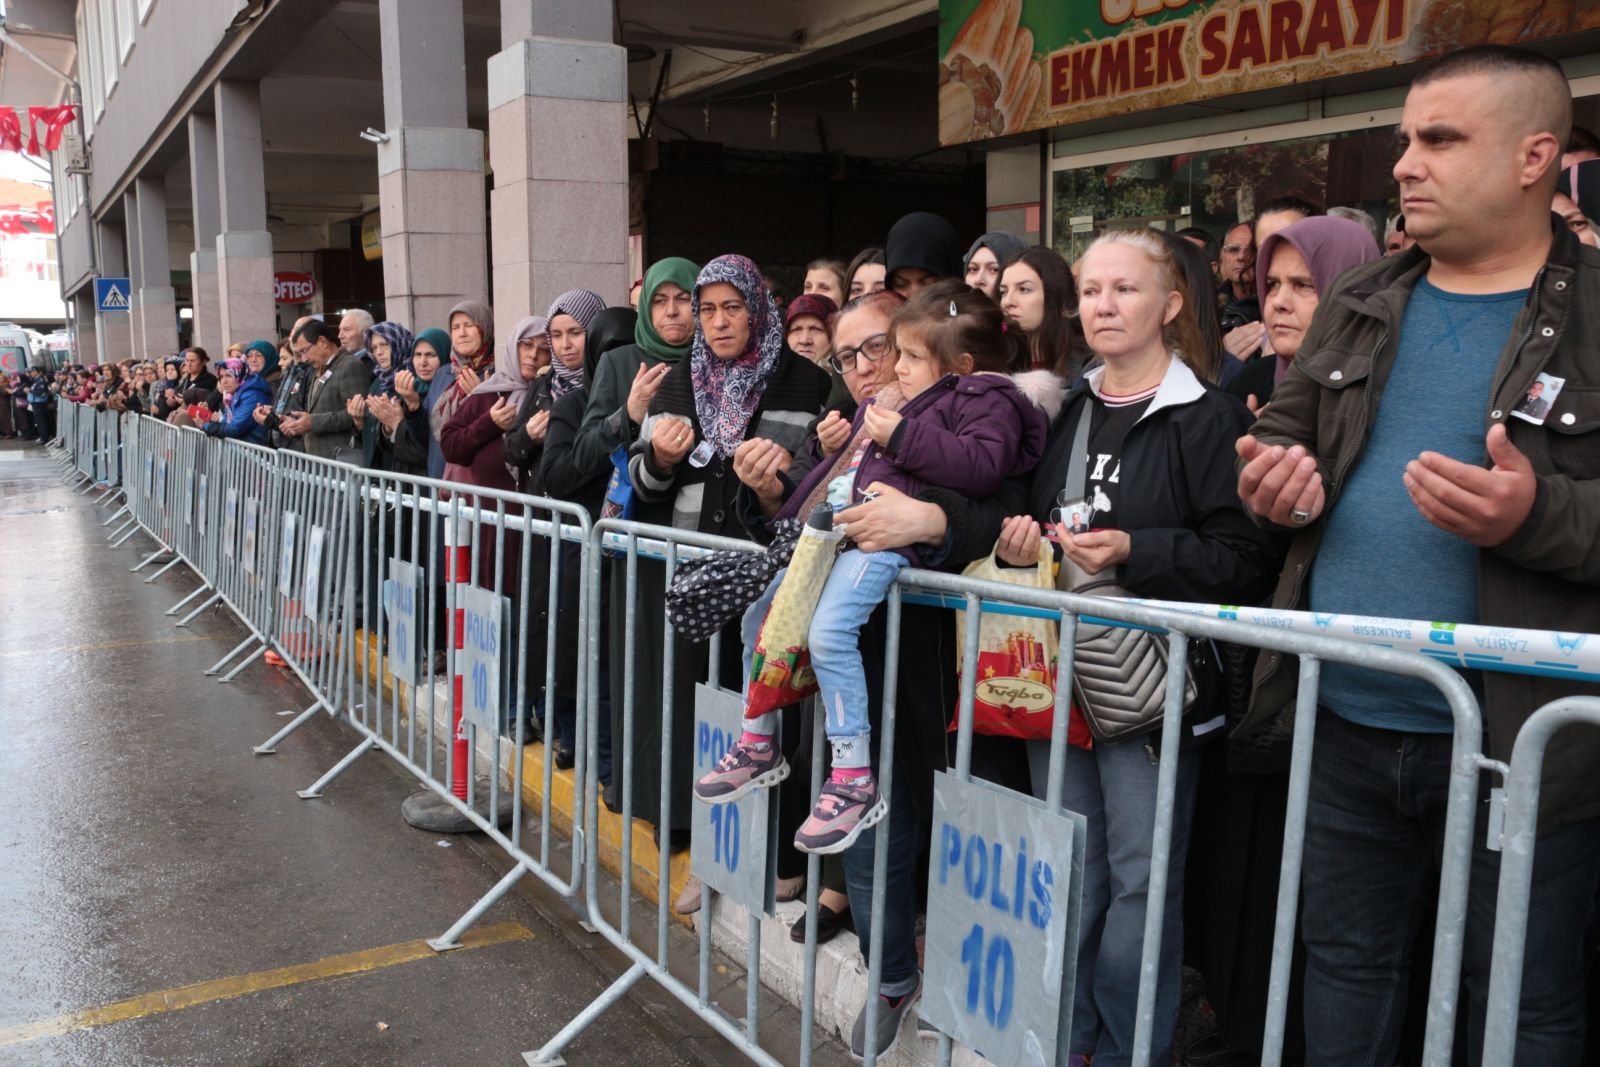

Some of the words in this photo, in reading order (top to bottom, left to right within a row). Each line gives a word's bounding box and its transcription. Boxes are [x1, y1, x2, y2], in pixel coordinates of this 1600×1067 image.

[1051, 26, 1186, 107] EKMEK
[1201, 0, 1405, 76] SARAYI
[1352, 624, 1412, 641] BALIKESİR
[1474, 635, 1529, 653] ZABITA
[472, 659, 488, 712] 10
[986, 681, 1044, 703] Tuğba
[710, 800, 740, 874] 10
[938, 822, 1053, 929] POLİS
[961, 923, 1014, 1031] 10
